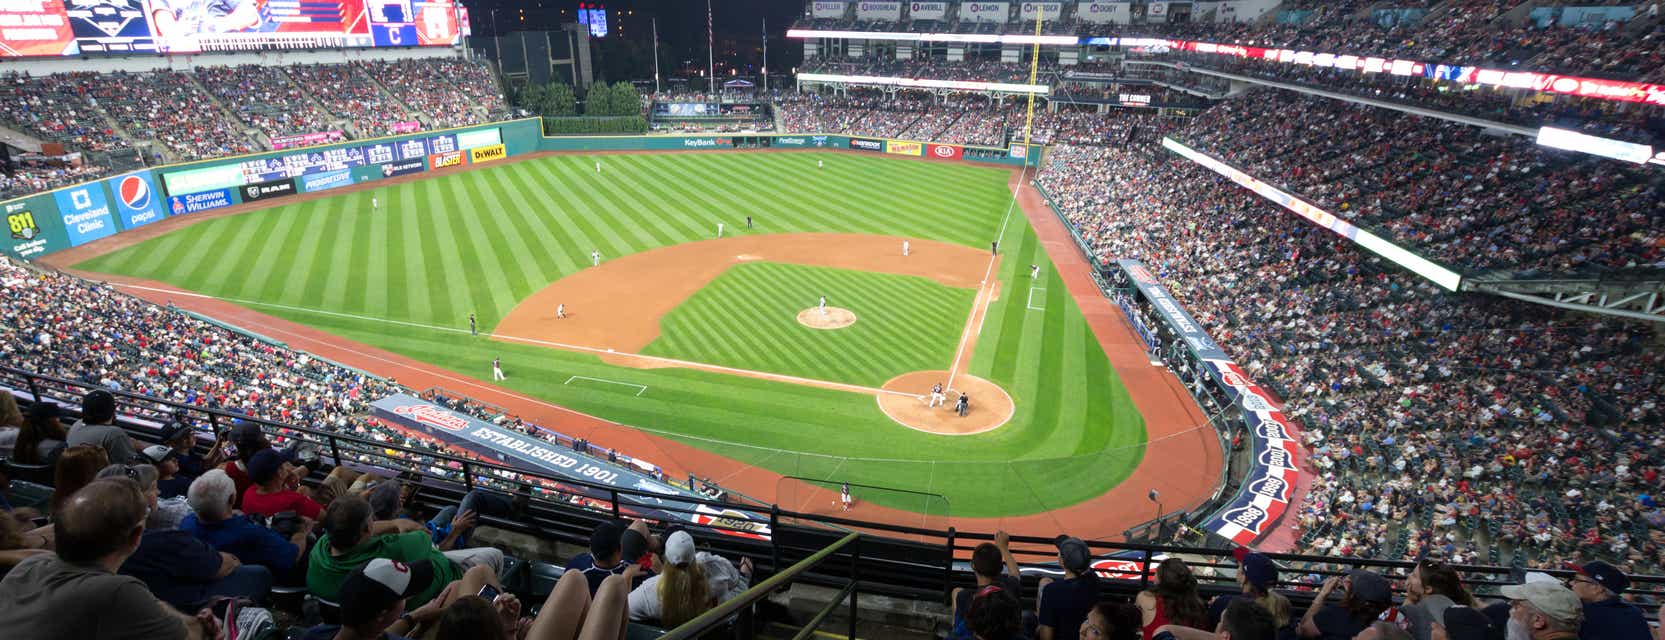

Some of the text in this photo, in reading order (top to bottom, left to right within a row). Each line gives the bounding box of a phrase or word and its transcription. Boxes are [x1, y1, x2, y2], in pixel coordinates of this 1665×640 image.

[684, 139, 715, 147] KeyBank
[186, 191, 224, 203] SHERWIN
[7, 211, 35, 233] 811
[64, 204, 110, 225] Cleveland
[131, 210, 155, 224] pepsi
[77, 219, 104, 234] Clinic
[470, 427, 577, 468] ESTABLISHED
[1233, 507, 1263, 527] 1998
